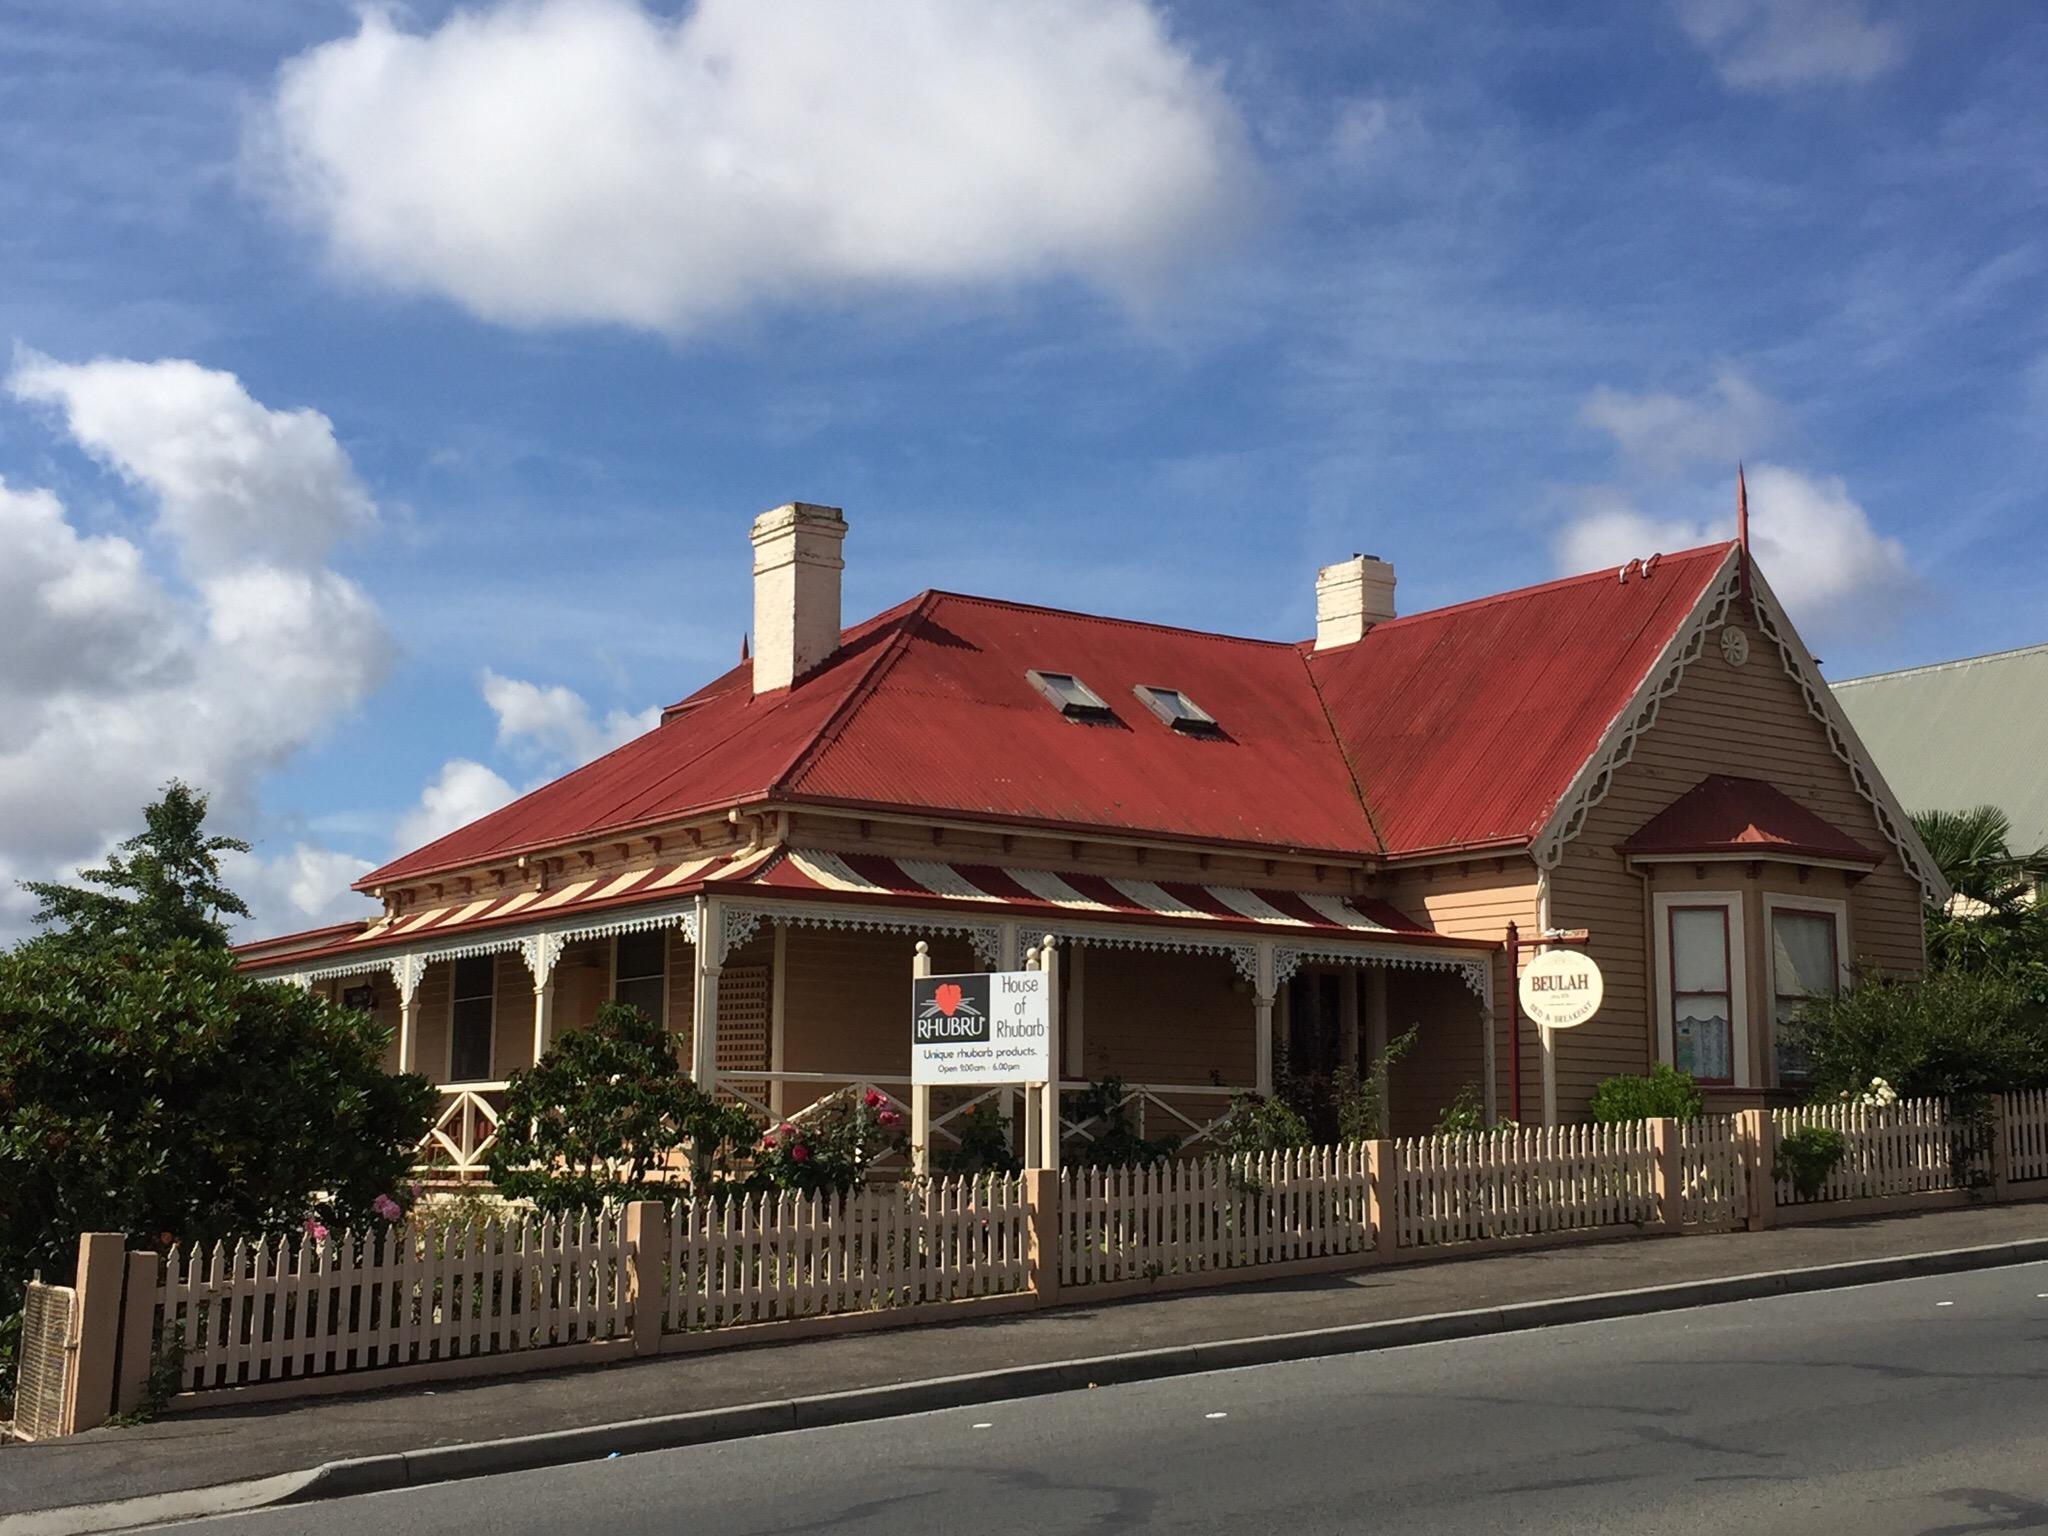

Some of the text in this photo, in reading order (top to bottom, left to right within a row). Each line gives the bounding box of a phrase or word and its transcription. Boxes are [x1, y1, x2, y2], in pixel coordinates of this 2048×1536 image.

[1002, 975, 1039, 993] House
[1531, 974, 1589, 992] BEULAH
[1014, 996, 1026, 1015] of
[917, 1016, 984, 1039] RHUBRU
[996, 1018, 1045, 1039] Rhubarb
[923, 1047, 1038, 1061] Unique rhubarb products.
[938, 1064, 958, 1074] Open
